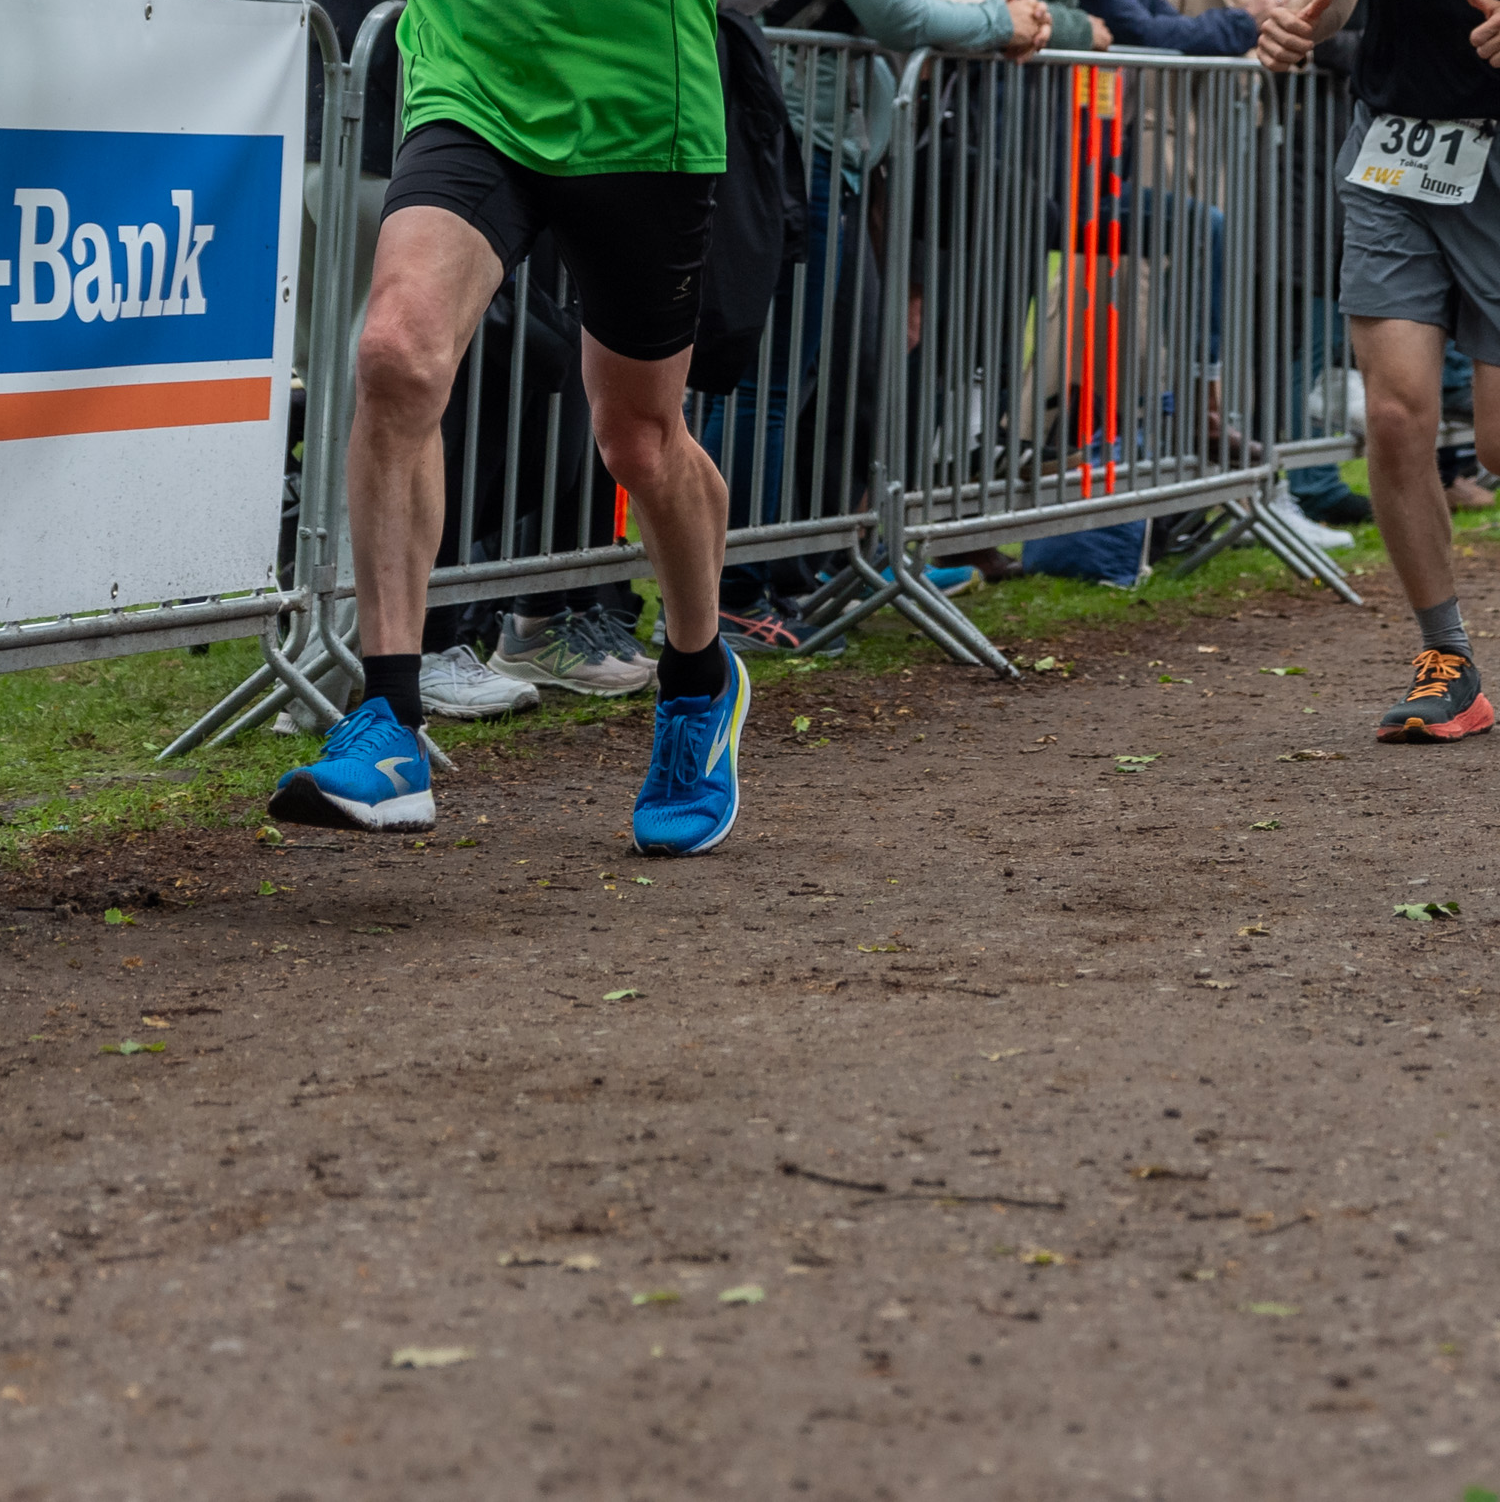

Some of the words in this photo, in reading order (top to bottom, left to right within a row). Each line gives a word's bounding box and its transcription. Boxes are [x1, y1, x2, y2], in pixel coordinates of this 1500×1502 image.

[1380, 117, 1466, 166] 301
[1400, 158, 1429, 170] Tobias
[1361, 166, 1405, 186] EWE
[1420, 173, 1465, 197] bruns
